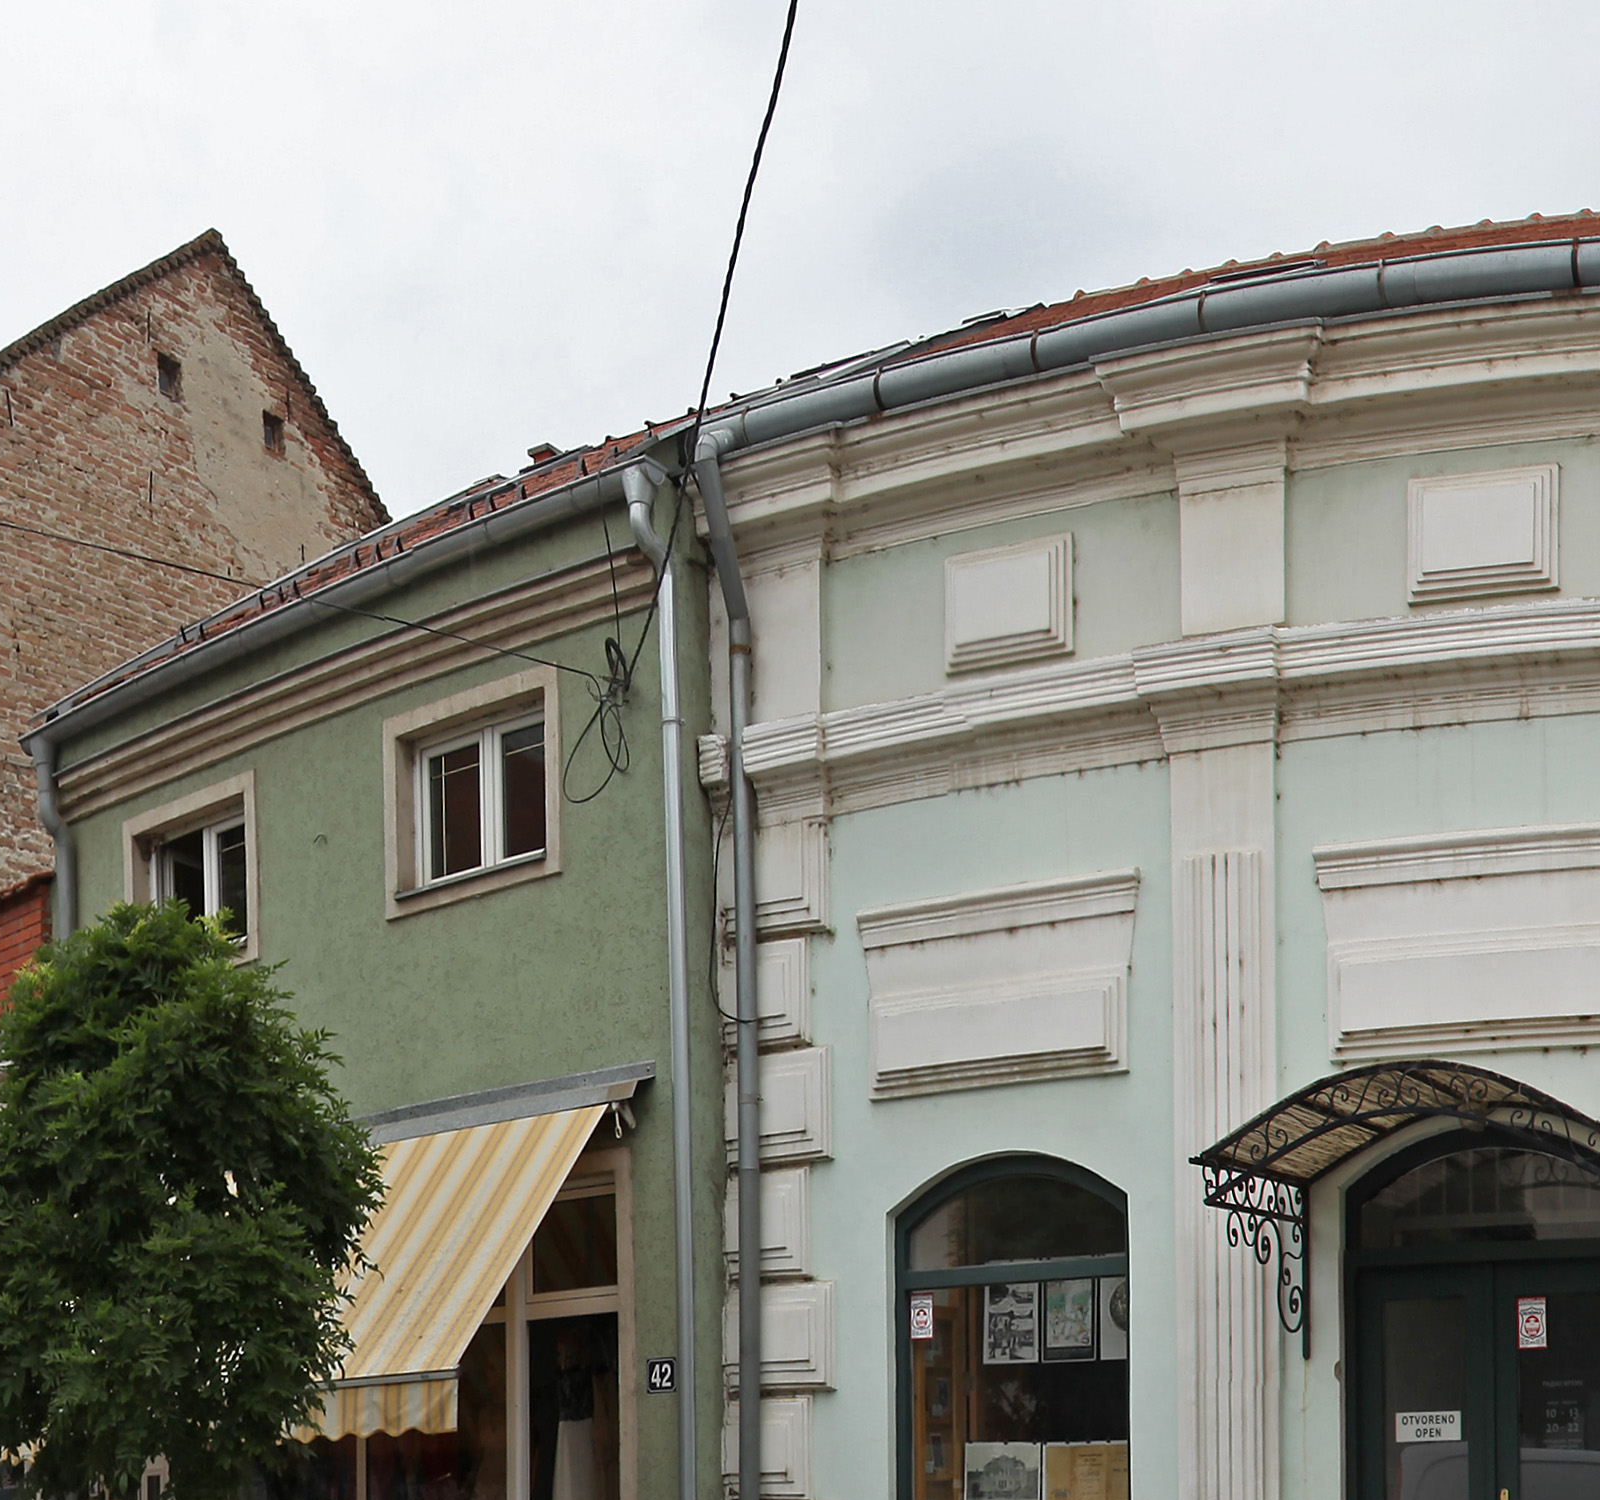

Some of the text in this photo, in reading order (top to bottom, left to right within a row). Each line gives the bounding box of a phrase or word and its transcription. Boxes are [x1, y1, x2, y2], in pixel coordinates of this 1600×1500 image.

[649, 1362, 673, 1390] 42
[1546, 1408, 1557, 1418] 10
[1401, 1414, 1455, 1426] OTVORENO
[1415, 1427, 1442, 1438] OPEN
[1546, 1423, 1559, 1433] 20
[1567, 1422, 1579, 1433] 22
